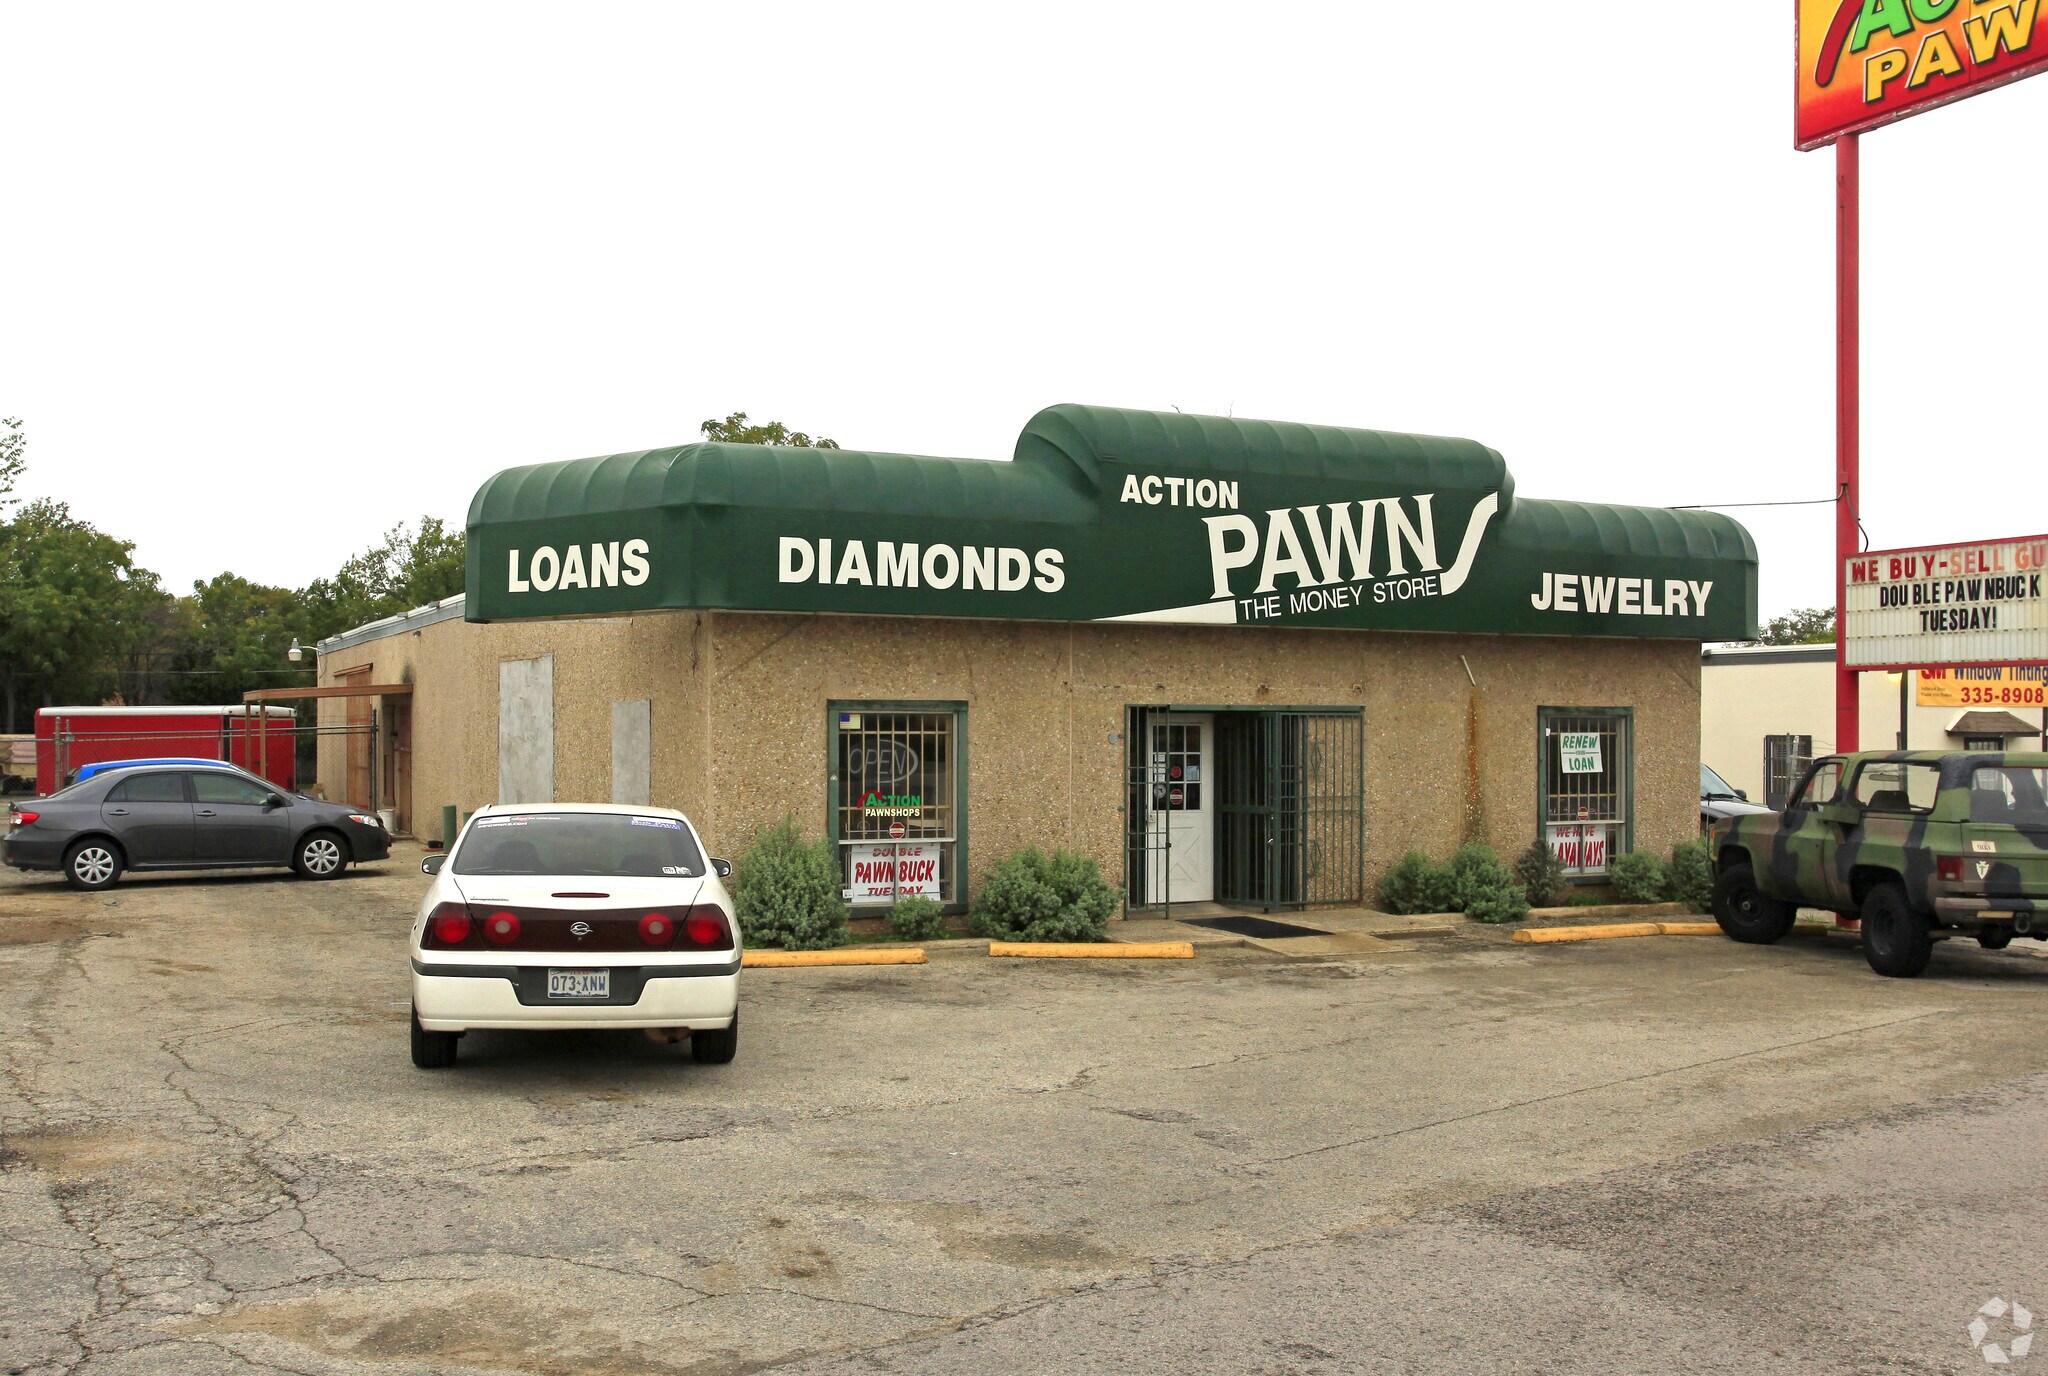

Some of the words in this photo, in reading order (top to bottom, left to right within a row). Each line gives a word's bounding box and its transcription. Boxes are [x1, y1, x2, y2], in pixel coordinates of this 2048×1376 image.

[1120, 474, 1239, 509] ACTION
[508, 538, 650, 593] LOANS
[778, 536, 1066, 593] DIAMONDS
[1852, 559, 1879, 583] WE
[1239, 598, 1282, 621] THE
[1290, 584, 1364, 615] MONEY
[1372, 575, 1438, 603] STORE
[1531, 572, 1714, 617] JEWELRY
[1880, 582, 1940, 608] DOUBLE
[1920, 606, 1998, 632] TUESDAY!
[1960, 687, 2044, 704] 335-8908
[1562, 735, 1598, 749] RENEW
[850, 748, 907, 775] OPEN
[1569, 756, 1595, 771] LOAN
[865, 793, 920, 807] ACTION
[865, 808, 921, 817] PAWNSHOPS
[1556, 826, 1571, 838] WE
[551, 975, 576, 992] 073
